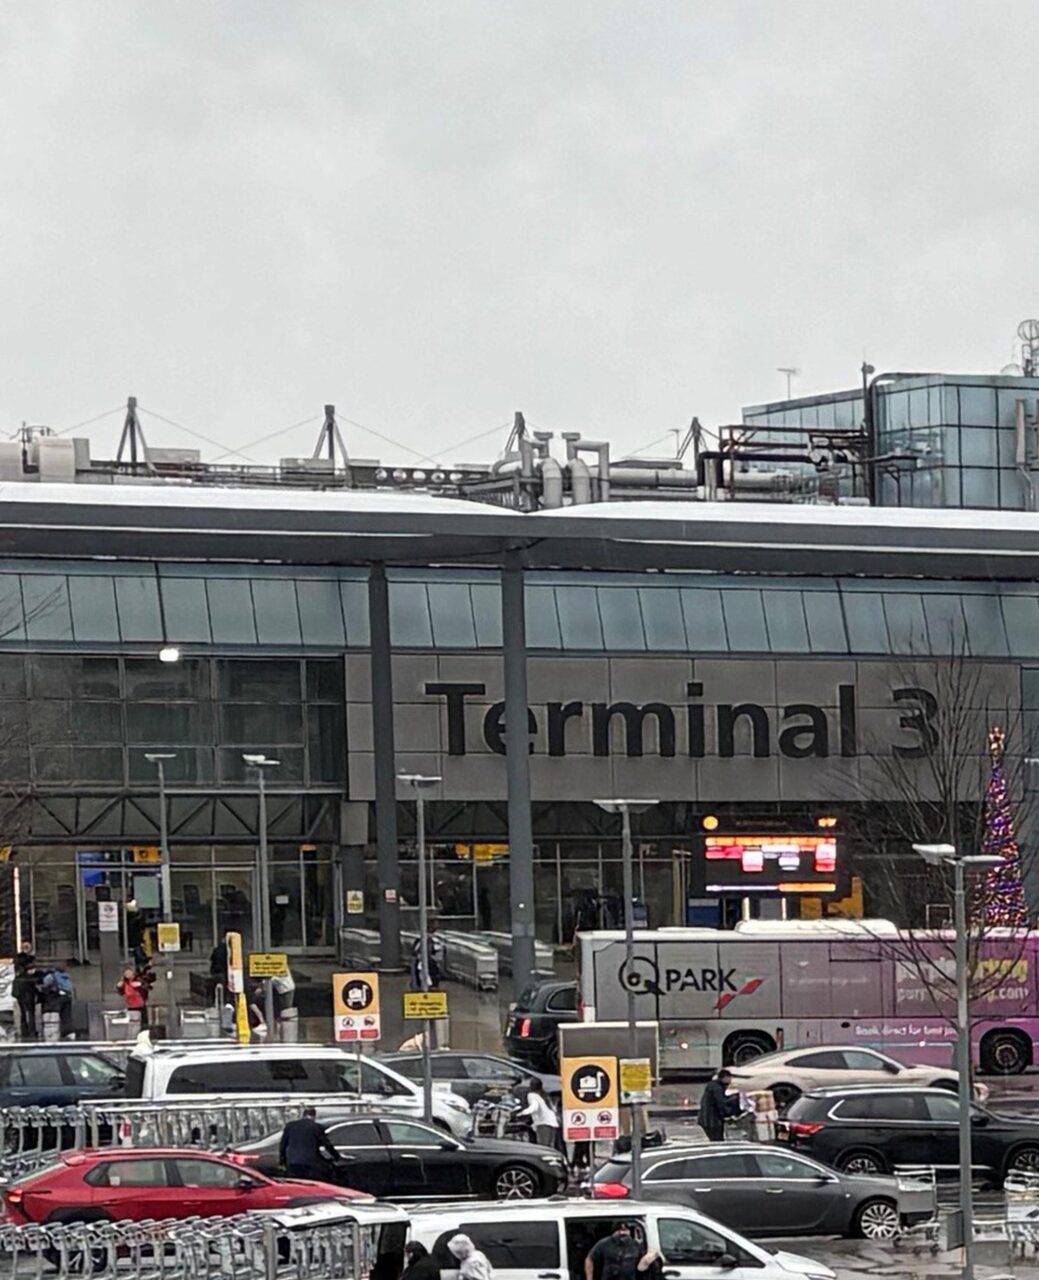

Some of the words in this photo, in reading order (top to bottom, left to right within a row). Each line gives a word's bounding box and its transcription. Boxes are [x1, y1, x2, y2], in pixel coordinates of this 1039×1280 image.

[424, 683, 856, 759] Terminal
[891, 687, 939, 759] 3
[665, 967, 738, 992] PARK
